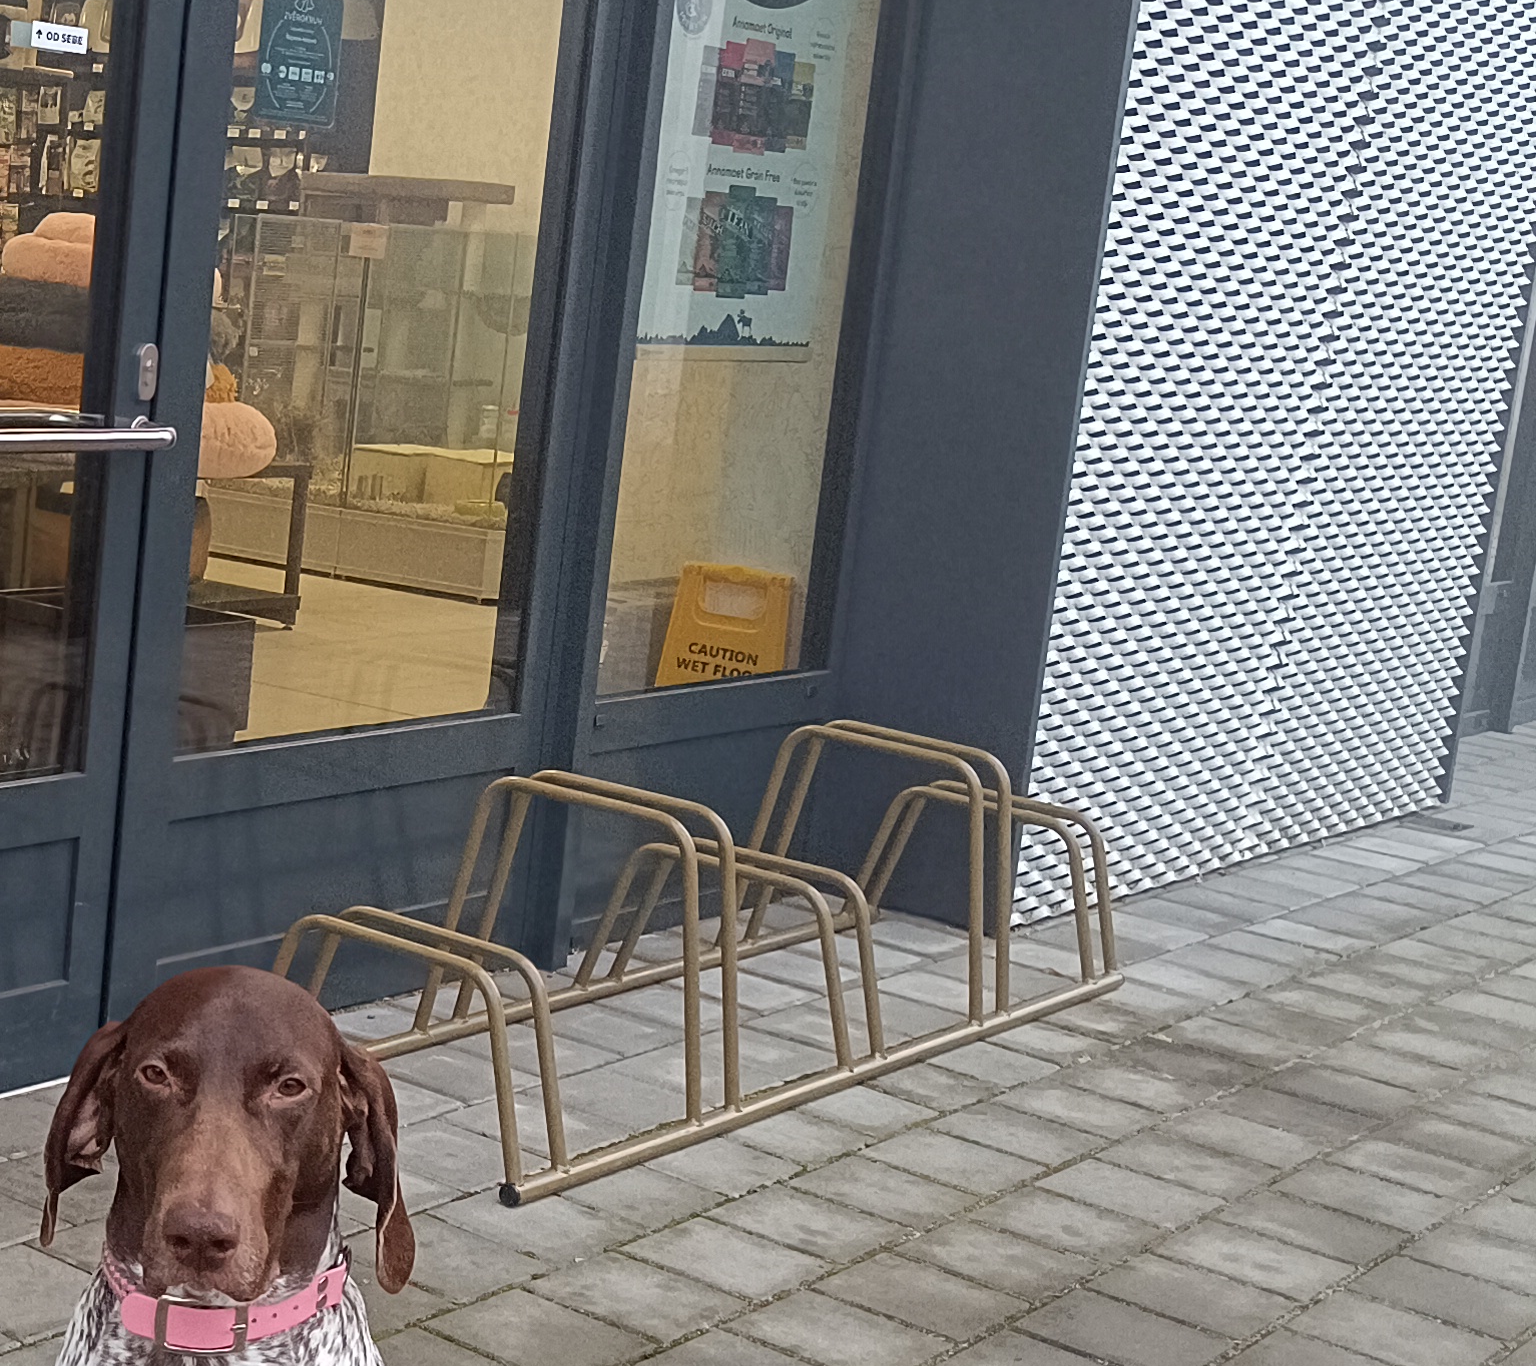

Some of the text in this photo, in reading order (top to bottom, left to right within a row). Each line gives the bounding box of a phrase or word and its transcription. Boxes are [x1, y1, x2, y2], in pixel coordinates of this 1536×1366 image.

[46, 31, 60, 42] OD
[688, 642, 759, 667] CAUTION
[676, 656, 710, 674] WET
